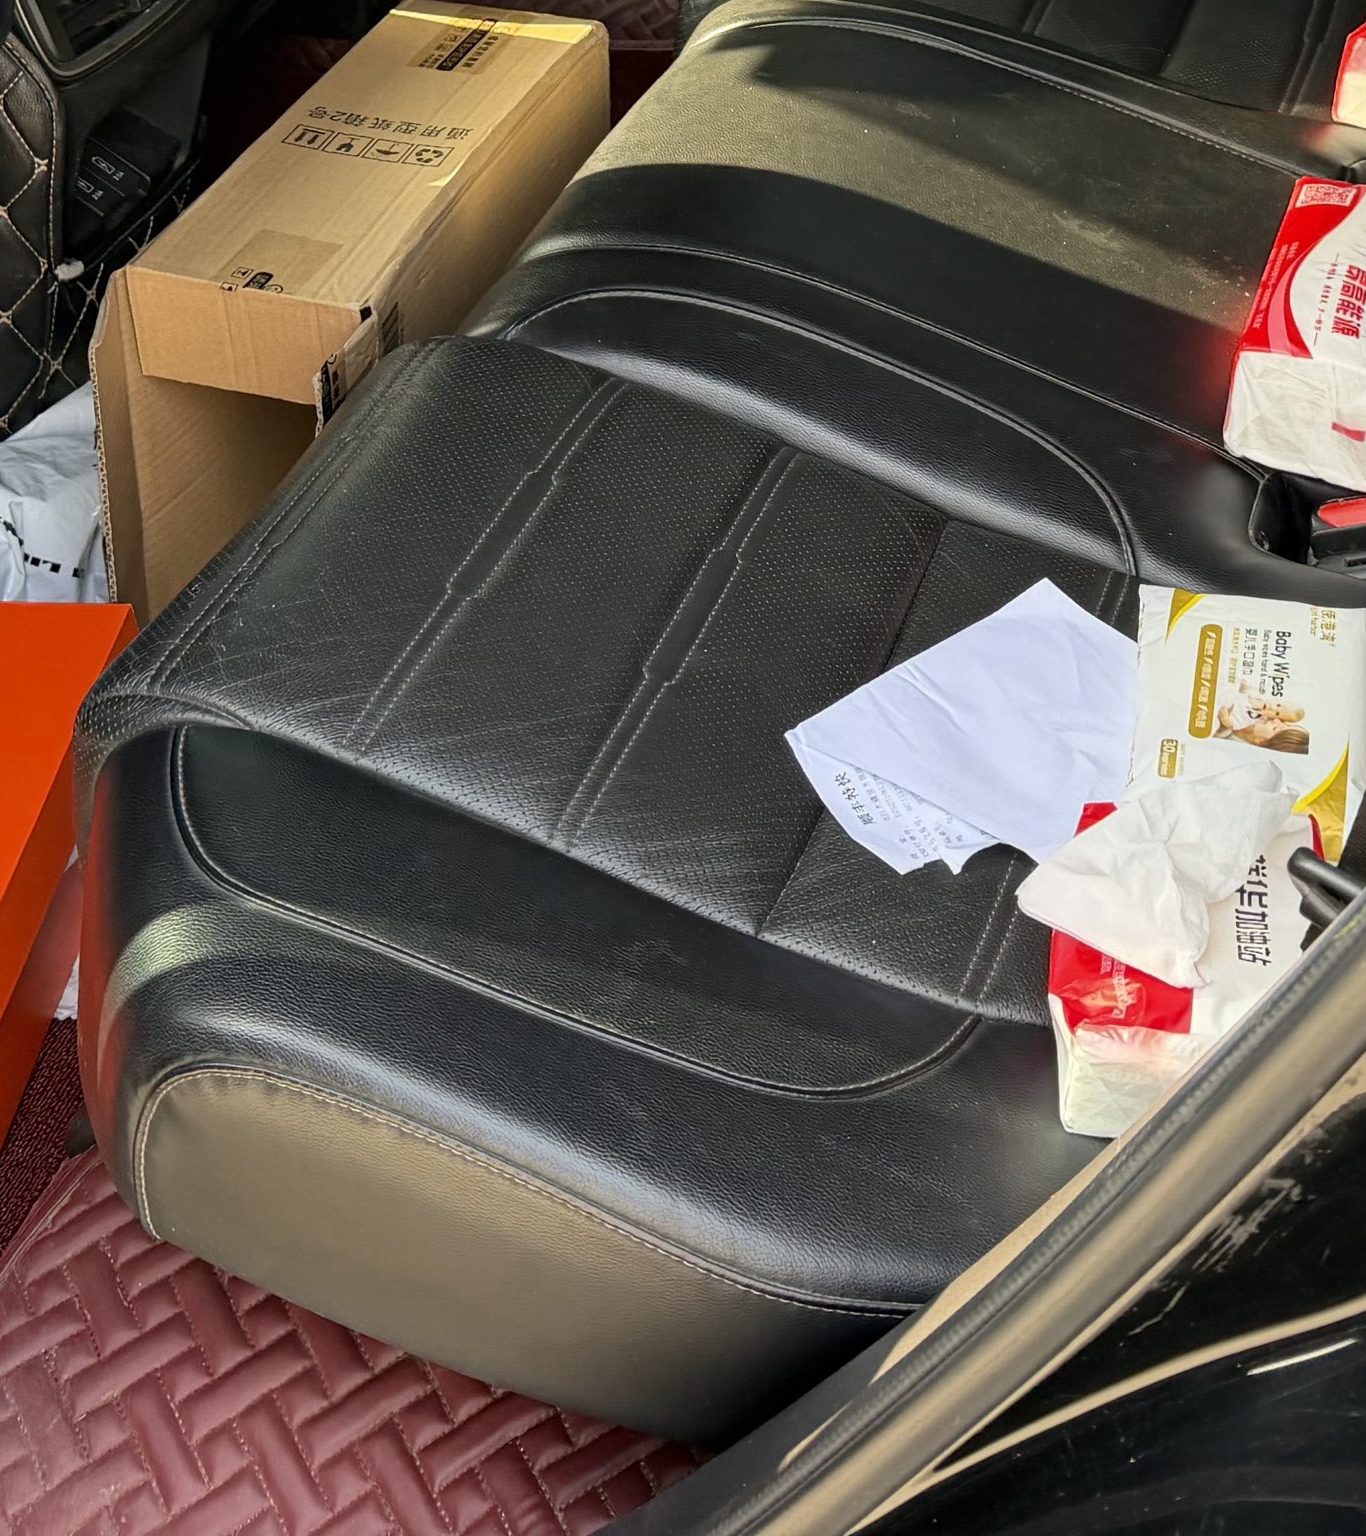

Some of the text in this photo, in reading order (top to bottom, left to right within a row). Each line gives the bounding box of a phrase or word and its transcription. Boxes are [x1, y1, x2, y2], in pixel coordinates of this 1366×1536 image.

[308, 106, 474, 141] 通用型纸箱2号
[1270, 631, 1291, 697] Baby Wipes
